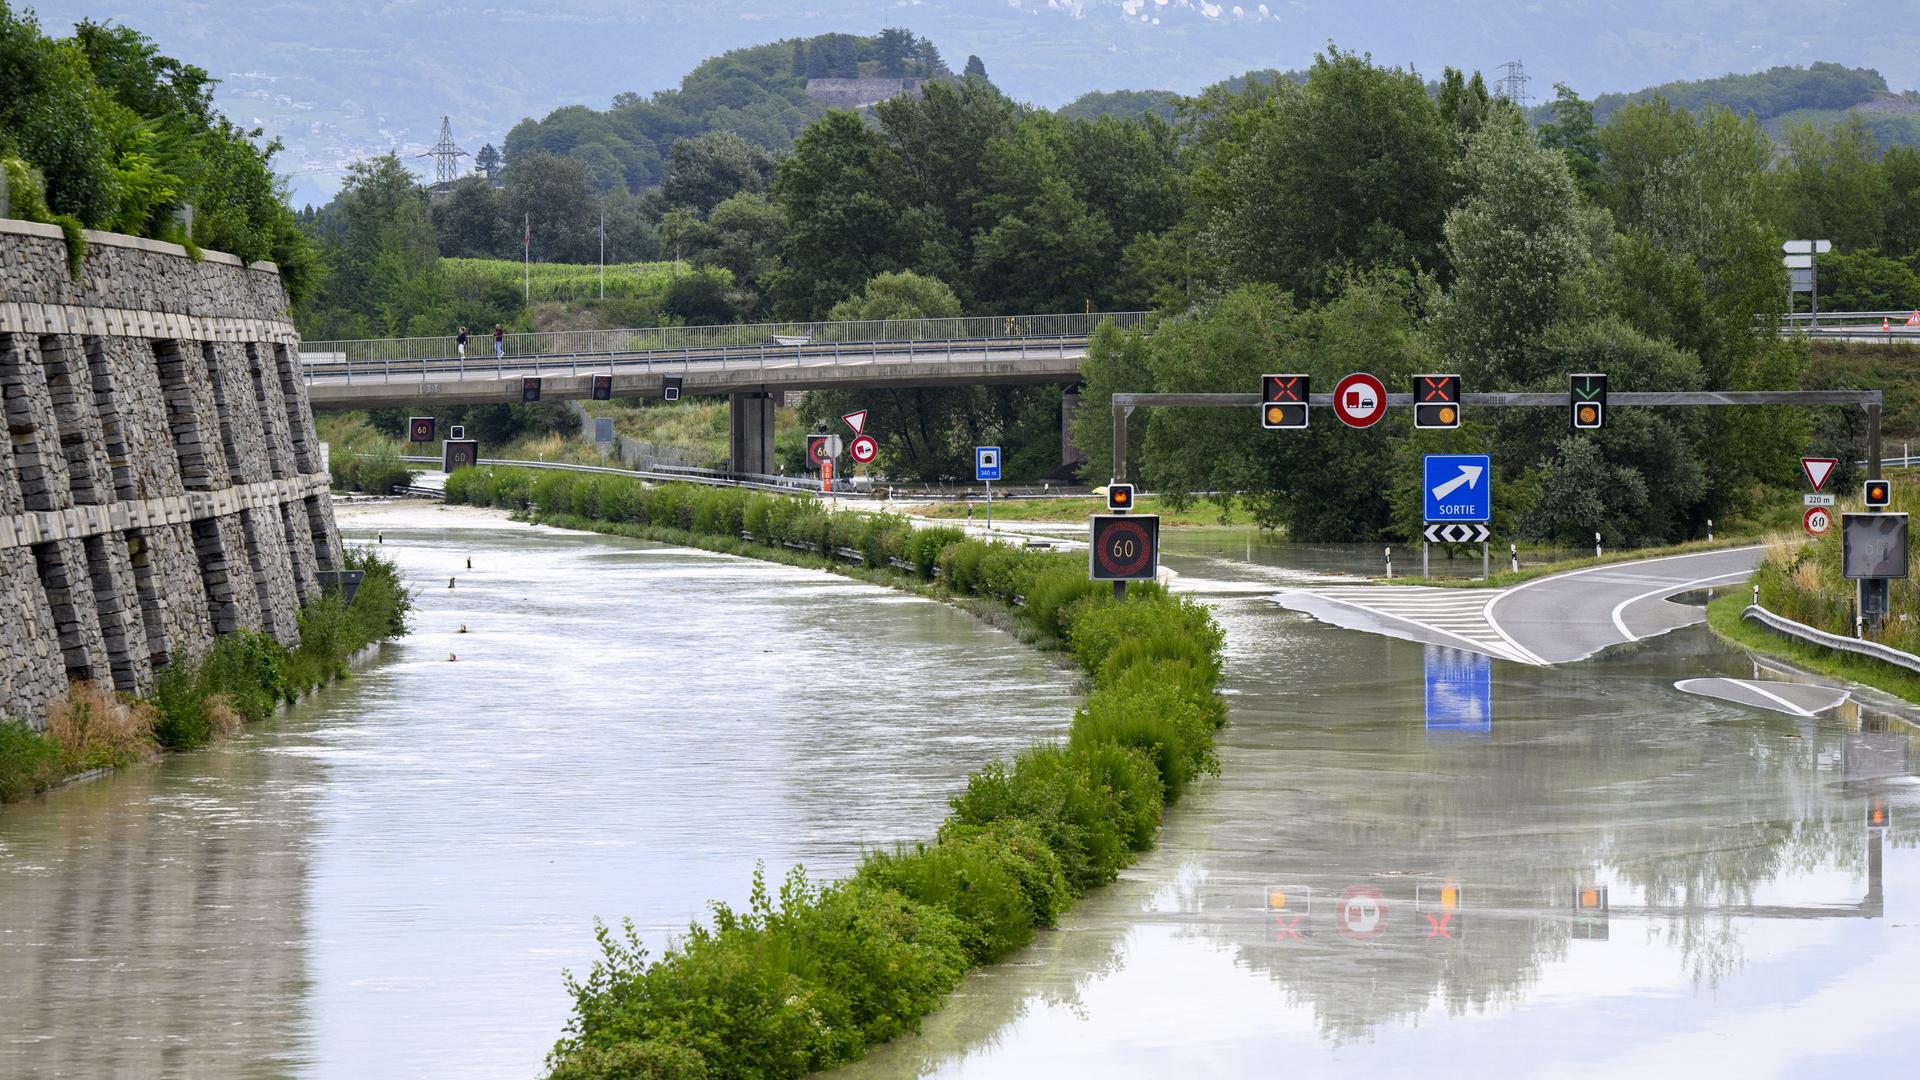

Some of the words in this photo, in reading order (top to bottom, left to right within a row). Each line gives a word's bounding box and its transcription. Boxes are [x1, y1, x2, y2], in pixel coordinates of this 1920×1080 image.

[417, 426, 427, 434] 60
[455, 452, 466, 461] 60
[1439, 505, 1475, 515] SORTIE
[1811, 516, 1825, 528] 60
[1113, 540, 1134, 558] 60
